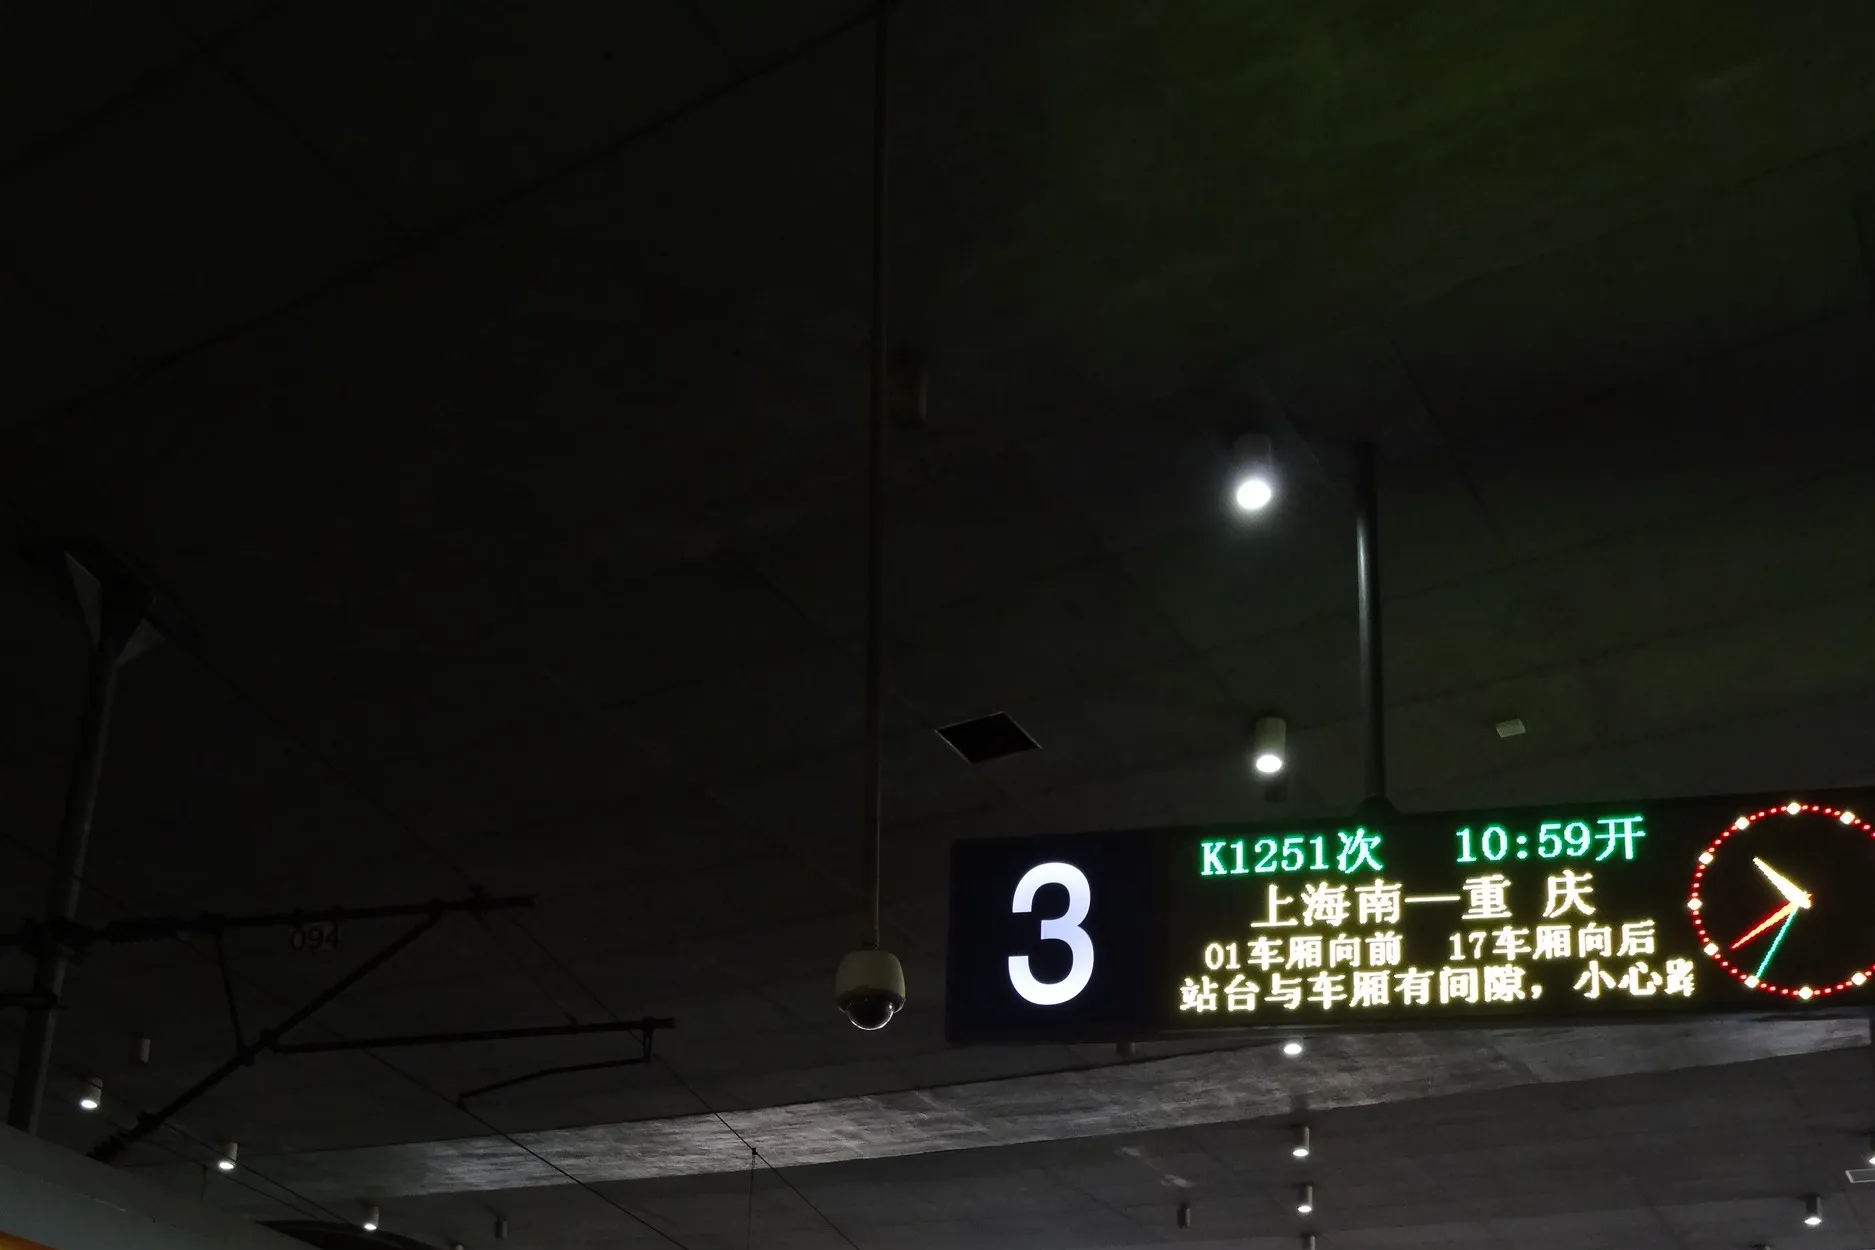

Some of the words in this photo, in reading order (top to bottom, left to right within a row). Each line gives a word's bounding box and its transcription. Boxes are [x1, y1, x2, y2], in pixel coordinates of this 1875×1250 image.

[1200, 828, 1384, 877] K1251次
[1456, 815, 1647, 864] 10:59开
[1008, 862, 1094, 1006] 3
[1204, 932, 1404, 971] 01车厢向前
[1448, 919, 1657, 962] 17车厢向后
